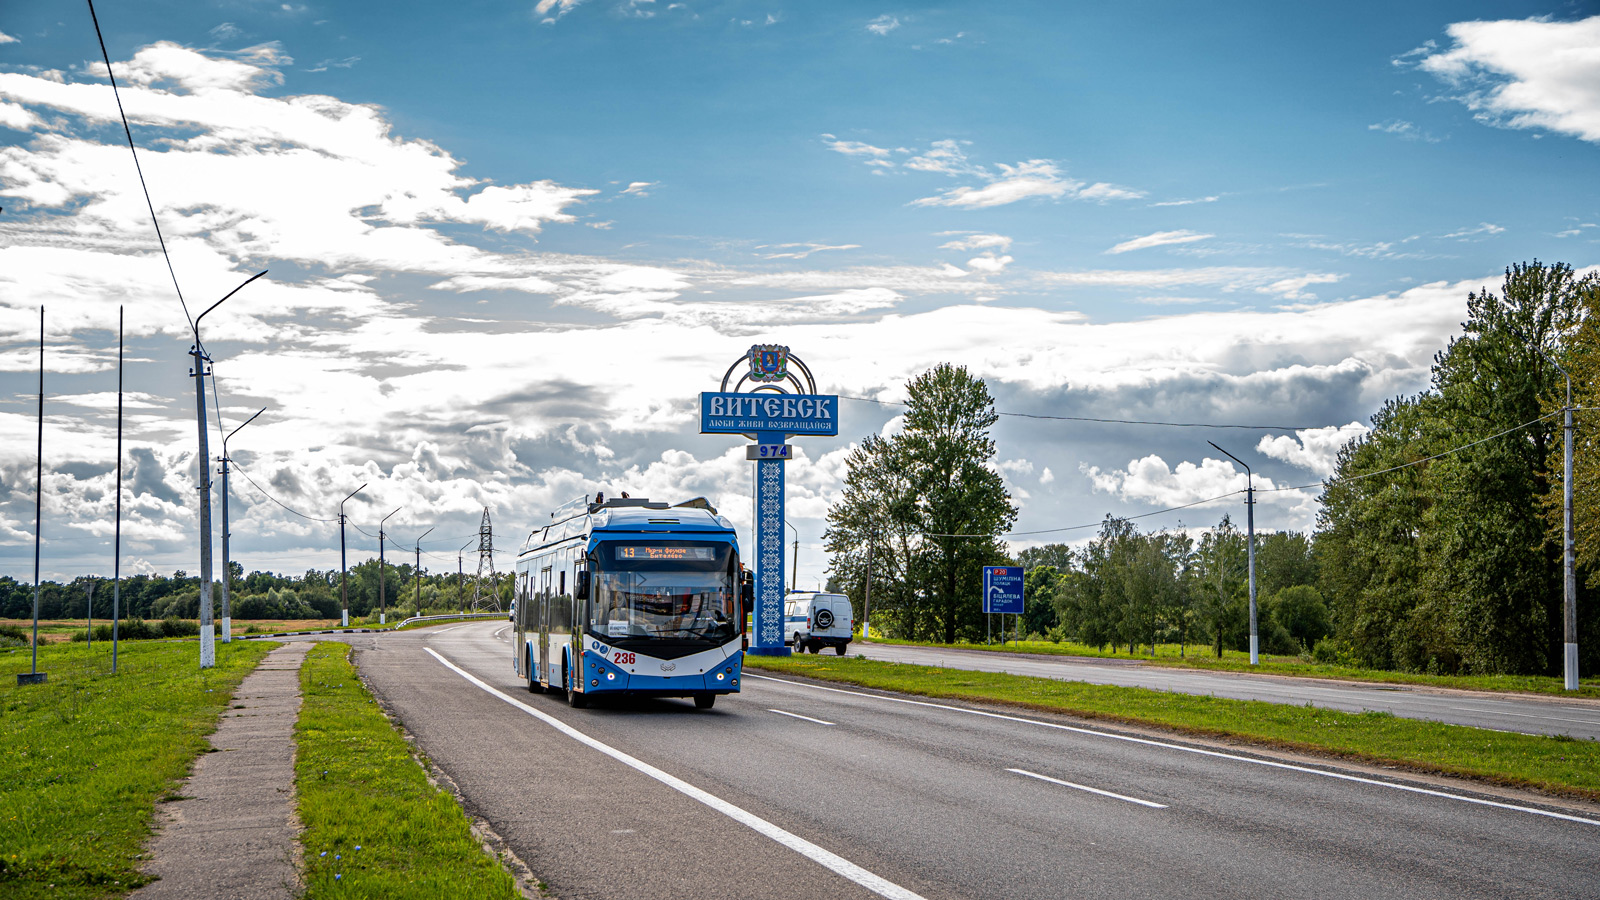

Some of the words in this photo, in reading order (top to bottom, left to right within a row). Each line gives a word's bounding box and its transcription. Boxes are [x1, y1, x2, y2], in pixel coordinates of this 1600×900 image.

[708, 396, 832, 419] ВИТЕБСК
[708, 419, 734, 427] ЛЮБИ
[738, 420, 764, 428] ЖИВИ
[768, 420, 832, 430] ВОЗВРАЩАЙСЯ
[760, 445, 788, 457] 974
[624, 547, 635, 558] 13
[664, 547, 687, 555] Фрунзе
[614, 652, 636, 665] 236
